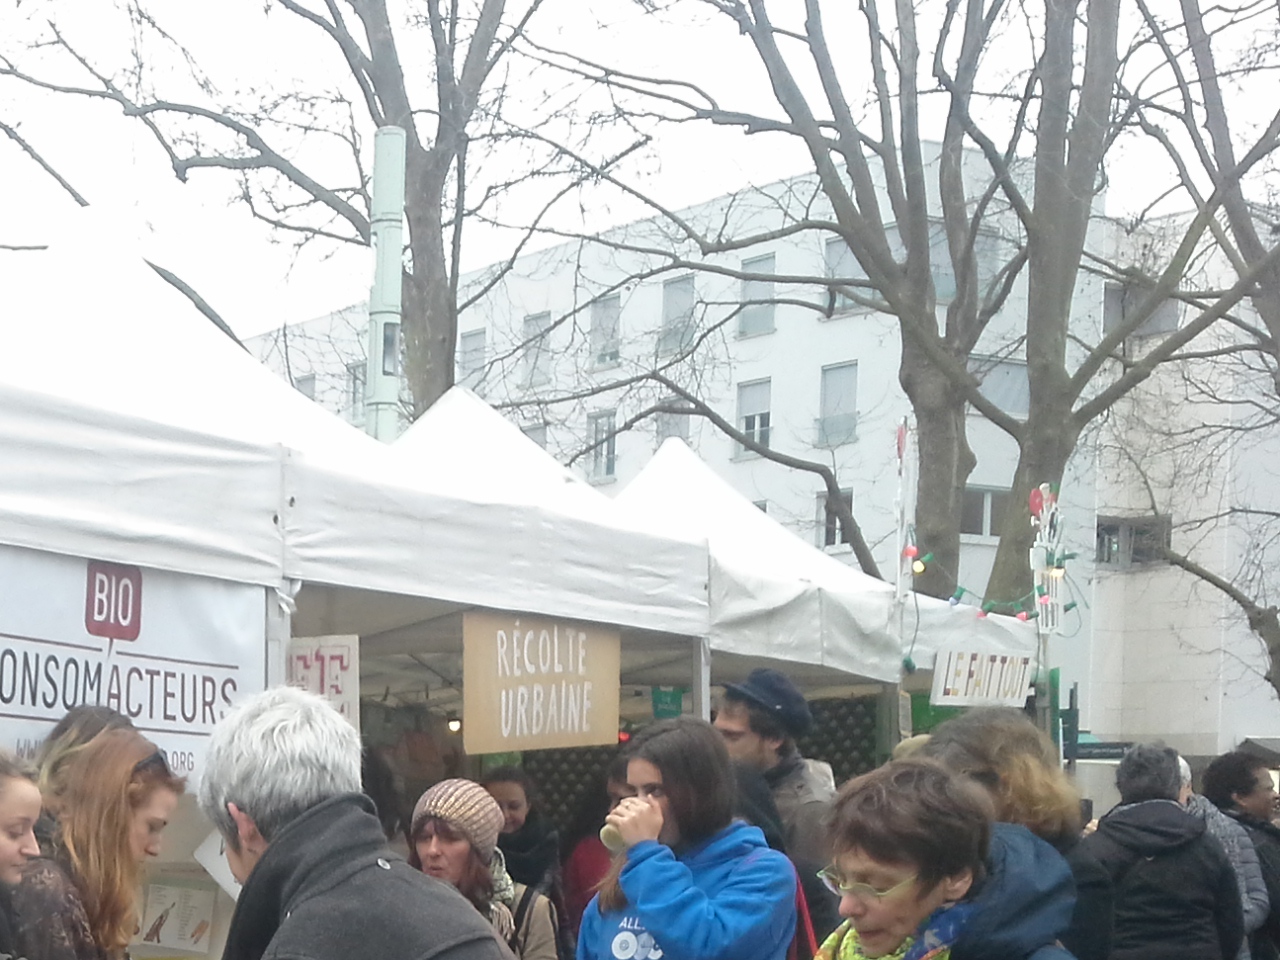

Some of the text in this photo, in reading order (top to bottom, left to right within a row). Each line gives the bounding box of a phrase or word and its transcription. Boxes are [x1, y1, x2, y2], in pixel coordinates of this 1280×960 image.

[92, 571, 134, 627] BIO
[496, 620, 587, 677] RÉCOLTE
[500, 680, 592, 738] URBAINE
